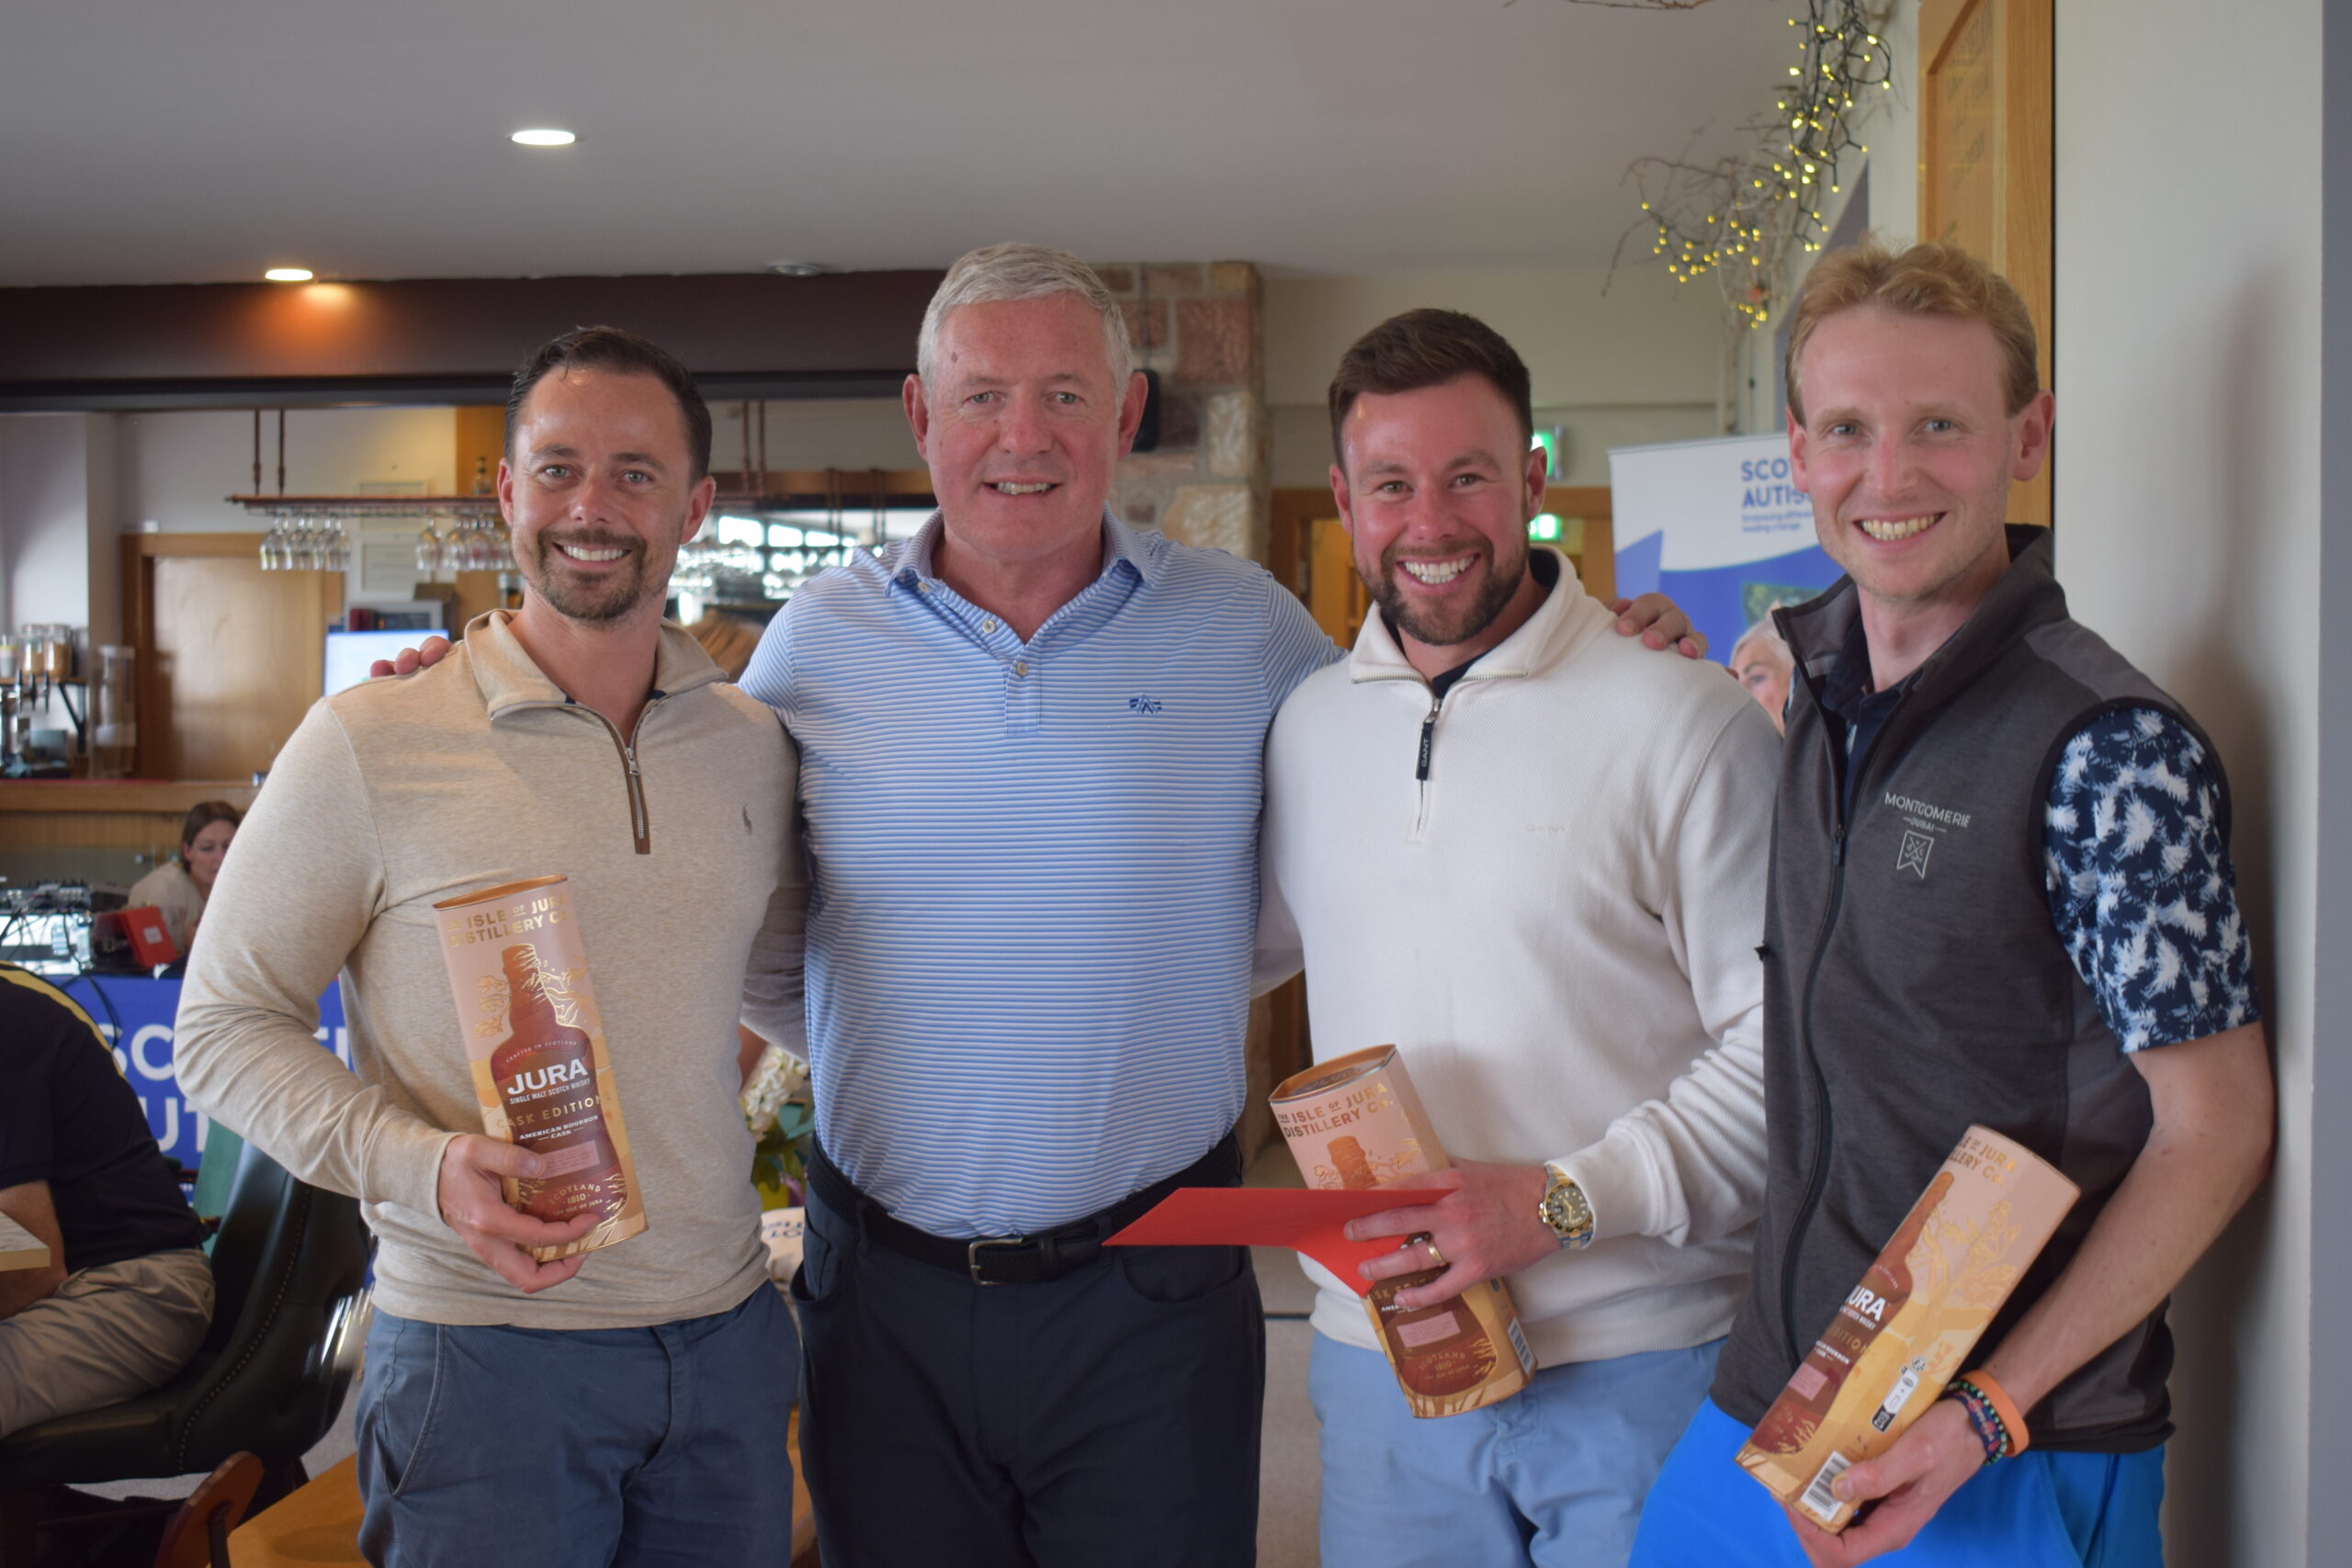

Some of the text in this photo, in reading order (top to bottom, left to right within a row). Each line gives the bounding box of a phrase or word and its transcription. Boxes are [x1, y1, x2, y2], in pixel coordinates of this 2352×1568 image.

[1741, 457, 1790, 481] SCO
[1742, 485, 1811, 508] AUTIS
[1884, 792, 1971, 828] MONTGOMERIE
[1911, 818, 1935, 831] DUBAI
[467, 909, 505, 929] ISLE
[513, 904, 526, 914] OF
[447, 915, 544, 948] DISTILLERY
[93, 1023, 175, 1081] SC
[545, 1039, 577, 1047] SCOTLAND
[507, 1058, 588, 1095] JURA
[510, 1077, 591, 1105] SINGLE MALT SCOTCH WHISKY
[1292, 1107, 1325, 1123] ISLE
[1329, 1101, 1340, 1110] OF
[1347, 1083, 1387, 1108] JURA
[497, 1113, 535, 1128] CASK
[519, 1114, 598, 1140] AMERICAN BOURBON
[1283, 1109, 1361, 1138] DISTILLERY
[551, 1130, 572, 1139] CASK
[1979, 1144, 2018, 1173] JURA
